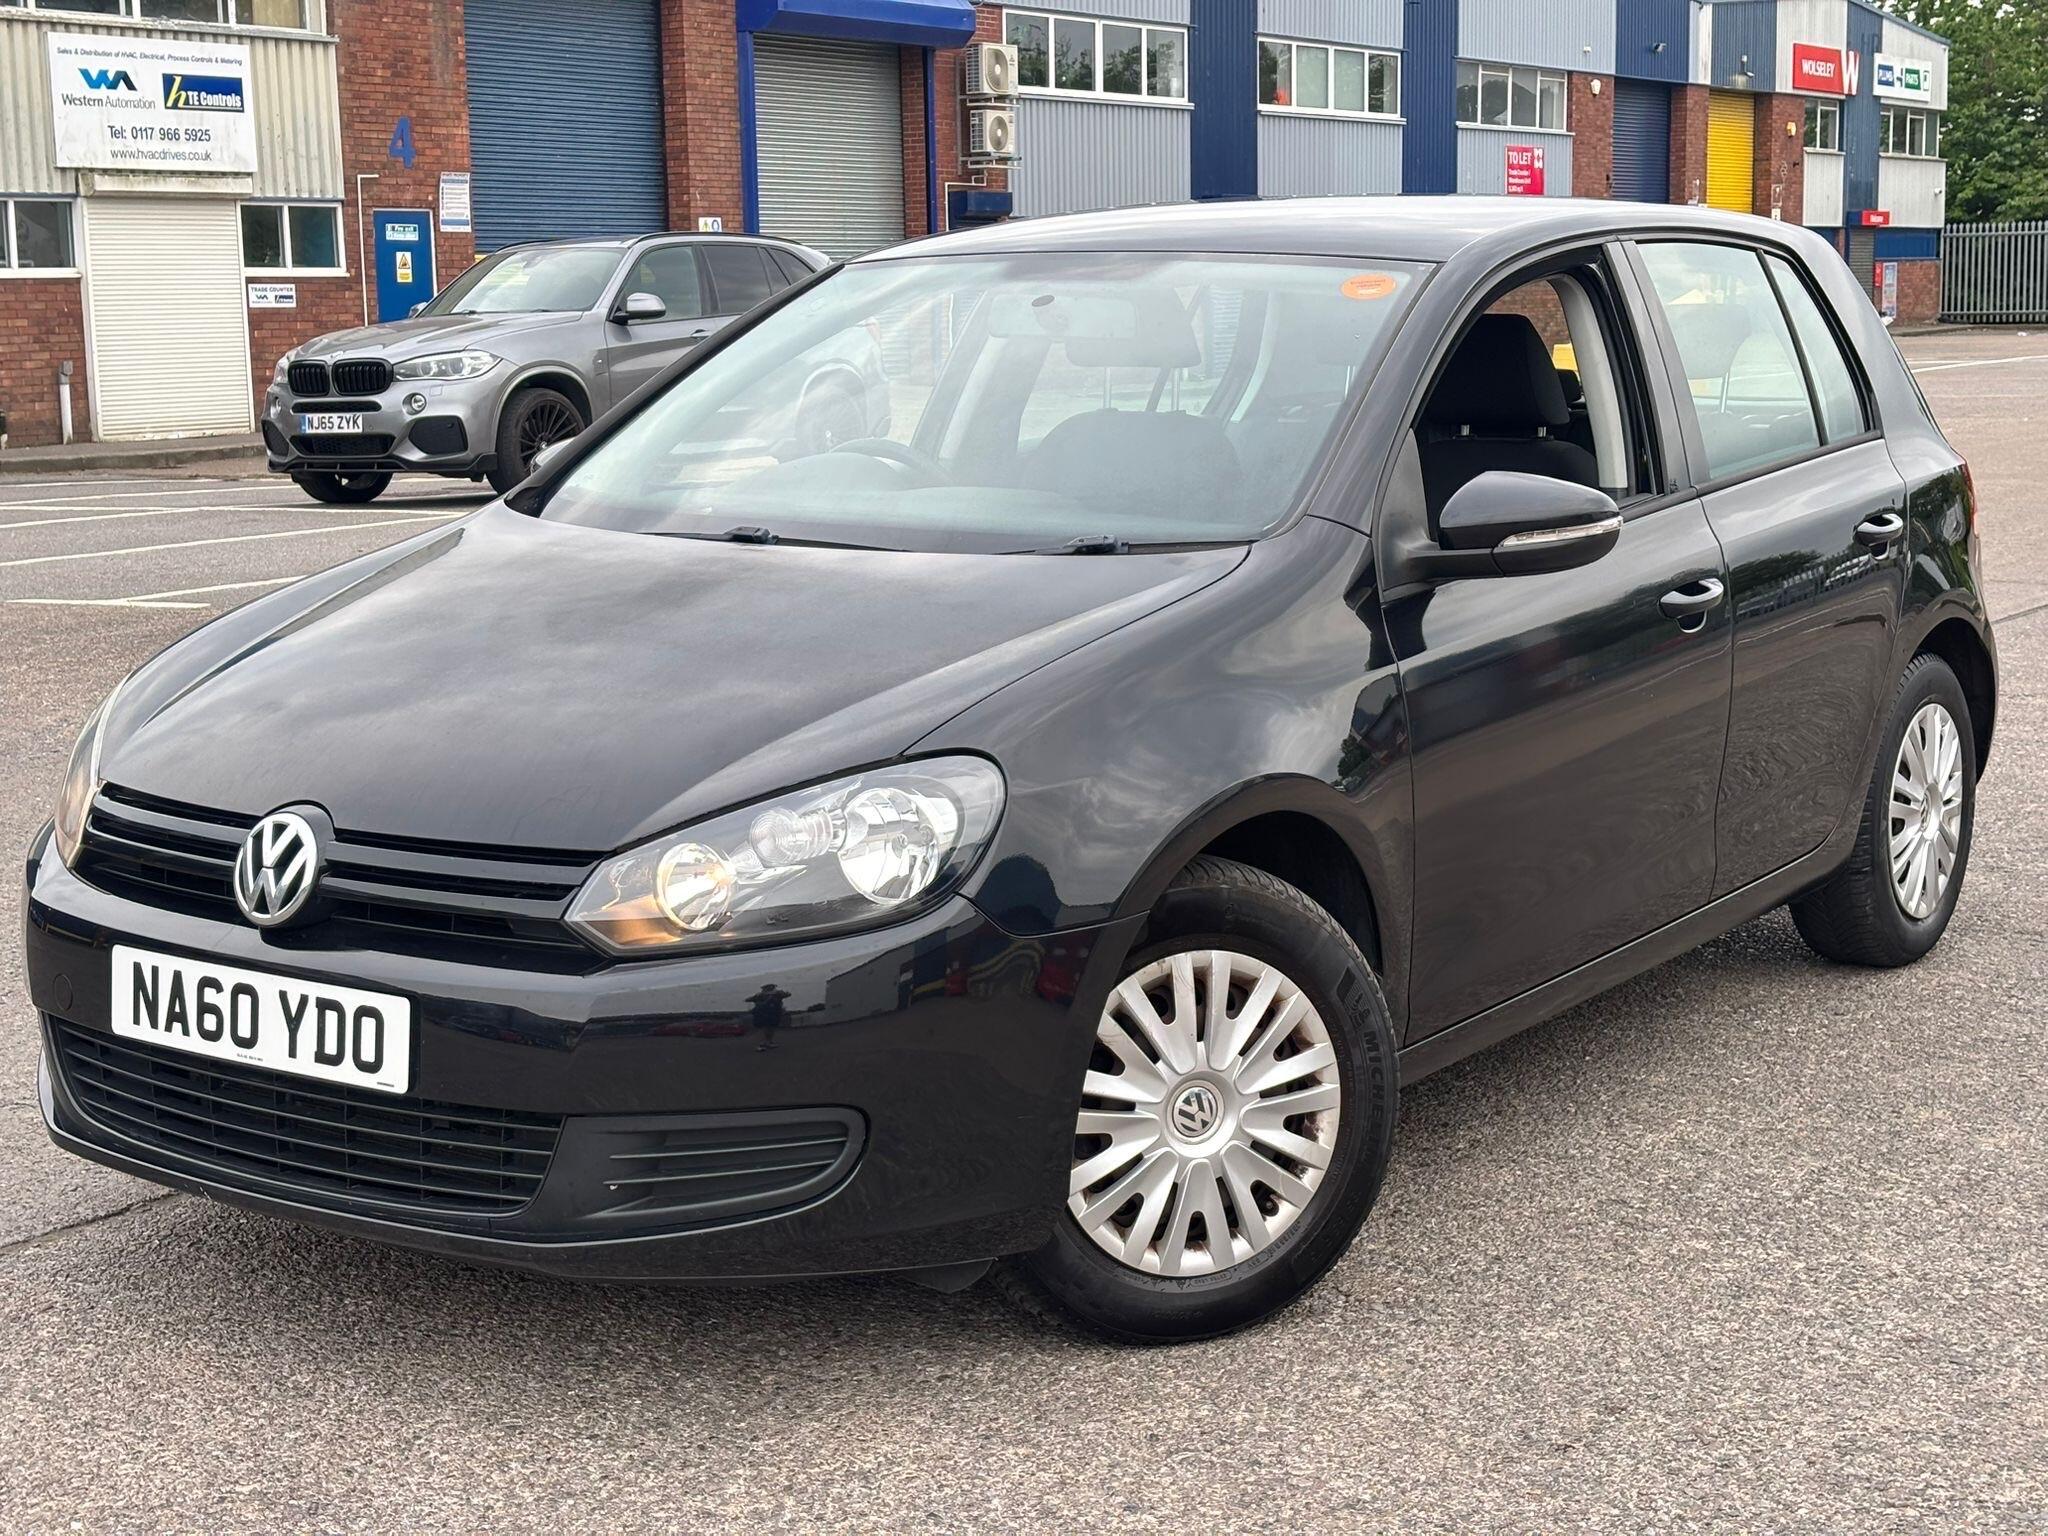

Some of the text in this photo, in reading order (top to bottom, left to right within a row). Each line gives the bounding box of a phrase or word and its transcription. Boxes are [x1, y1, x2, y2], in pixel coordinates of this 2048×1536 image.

[57, 47, 73, 55] Sales
[80, 48, 113, 57] Distribution
[167, 54, 189, 62] Process
[191, 55, 213, 63] Controls
[1801, 59, 1835, 77] WOLSELEY
[61, 93, 156, 110] Western Automation
[200, 91, 242, 107] Controls
[108, 125, 211, 142] Tel: 0117 966 5925
[389, 116, 416, 169] 4
[110, 148, 212, 161] www.hvacdrives.co.uk
[1508, 151, 1531, 165] TO LET
[307, 415, 360, 430] NJ65 ZYK
[133, 961, 385, 1075] NA60 YDO
